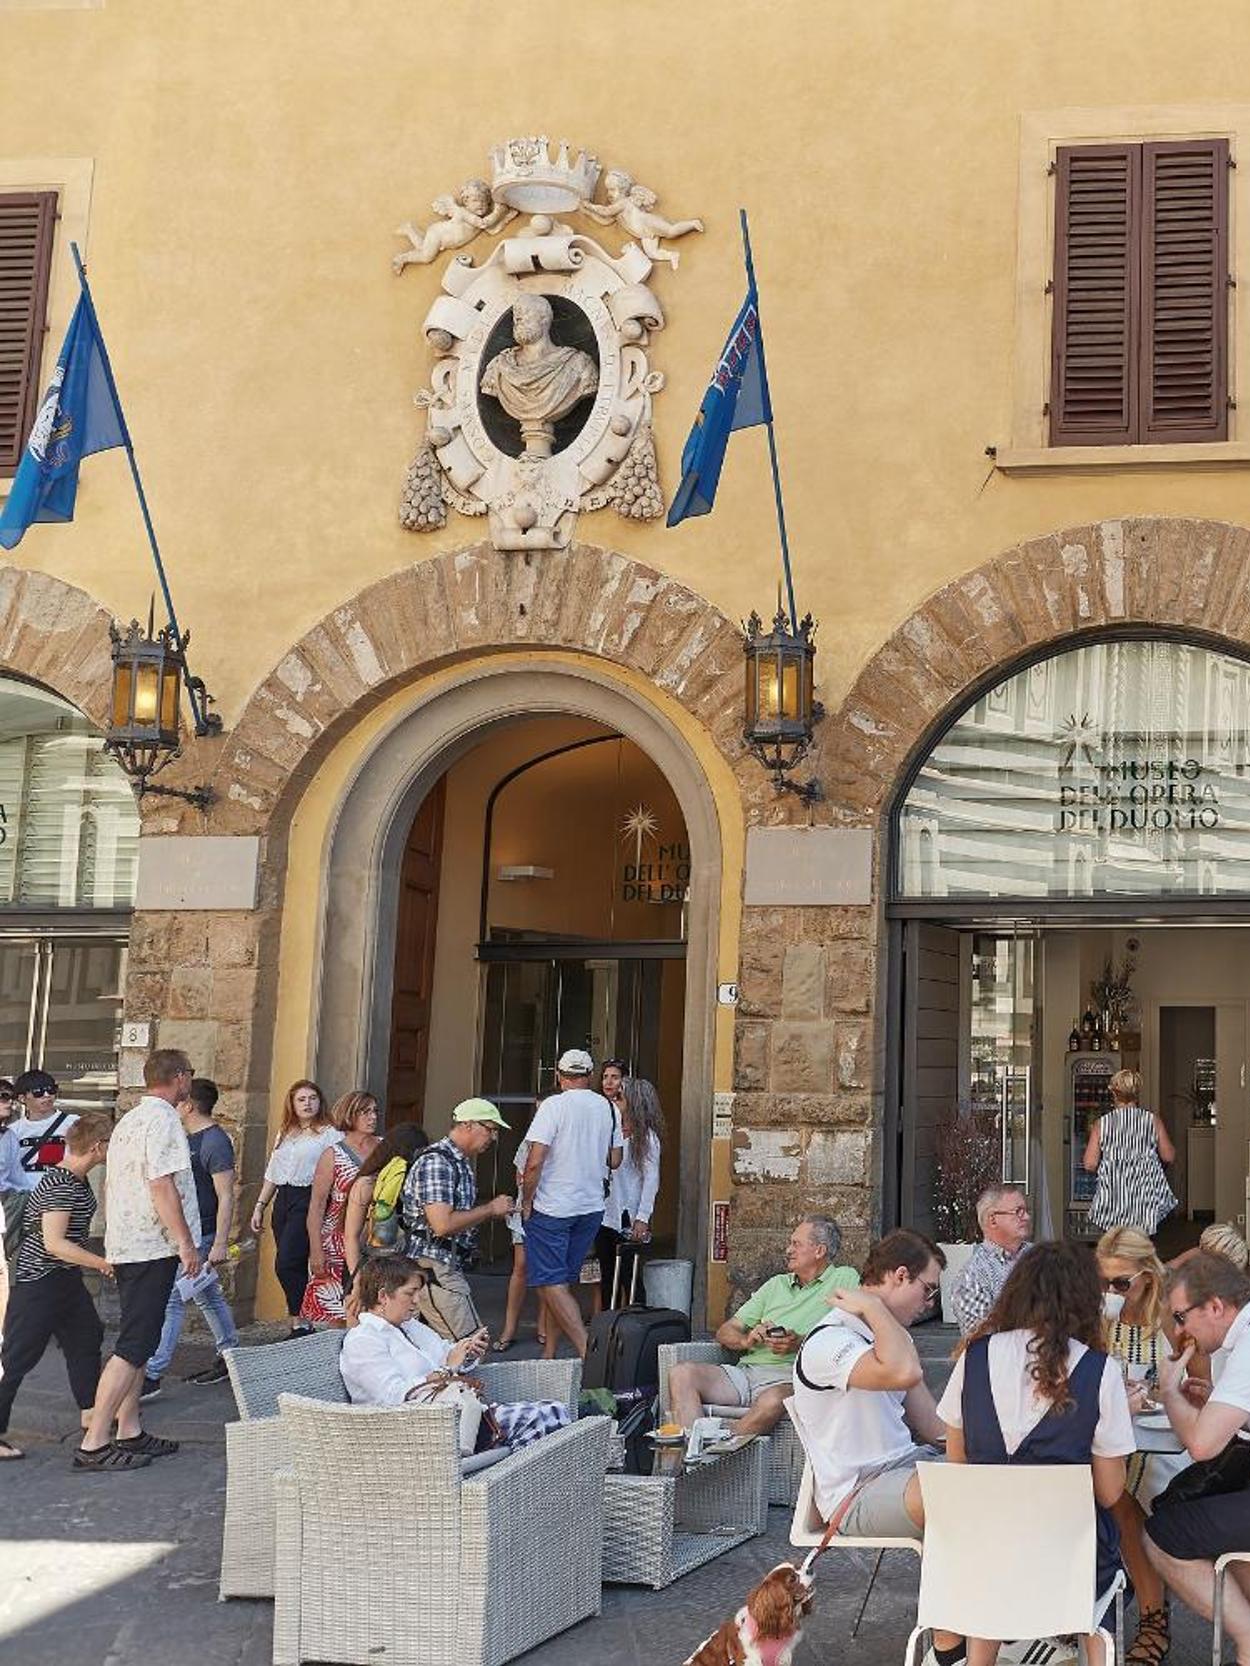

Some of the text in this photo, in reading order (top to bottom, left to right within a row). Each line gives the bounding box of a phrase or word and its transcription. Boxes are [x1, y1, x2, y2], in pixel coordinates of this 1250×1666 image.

[1107, 759, 1201, 781] MUSEO
[1130, 784, 1218, 806] OPERA
[1060, 807, 1219, 831] DEL DUOMO
